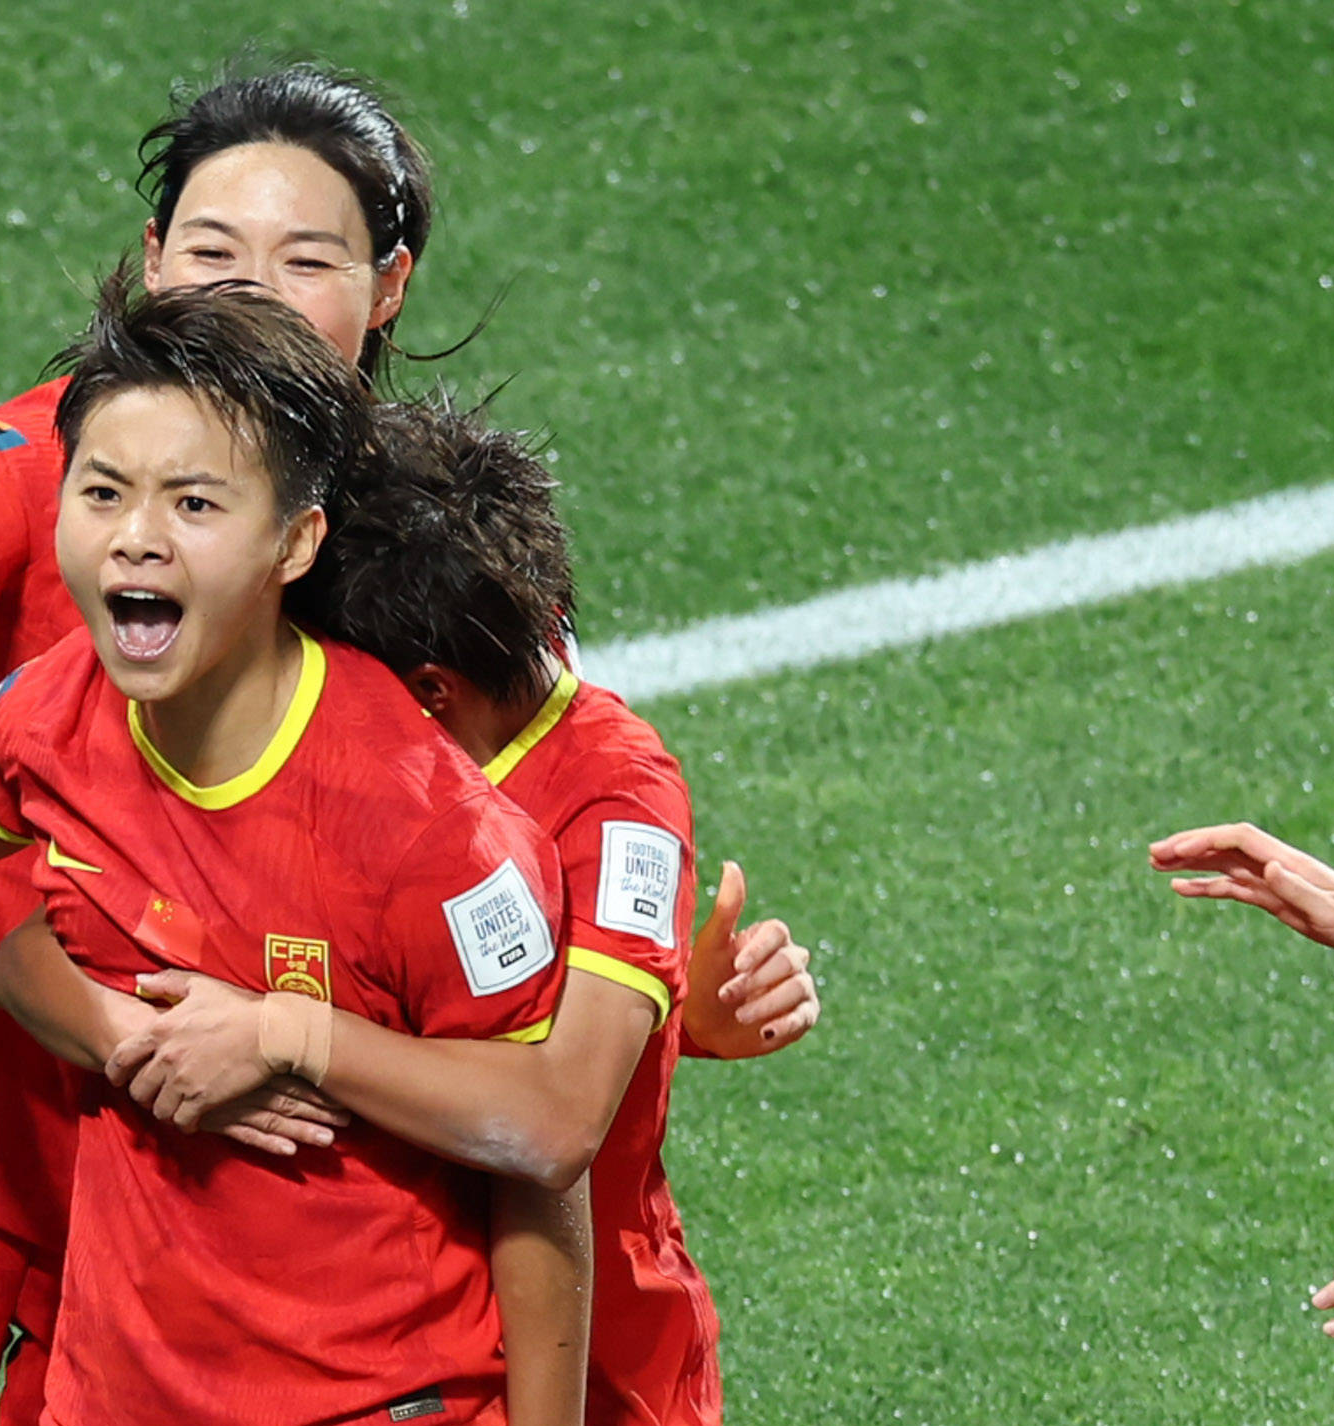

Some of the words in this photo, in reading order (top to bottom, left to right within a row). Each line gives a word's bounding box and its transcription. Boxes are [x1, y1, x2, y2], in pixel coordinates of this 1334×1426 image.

[626, 841, 669, 865] FOOTBALL
[625, 856, 669, 886] UNITES
[470, 889, 515, 922] FOOTBALL
[475, 900, 523, 940] UNITES
[271, 941, 323, 962] CFA
[479, 941, 498, 957] the
